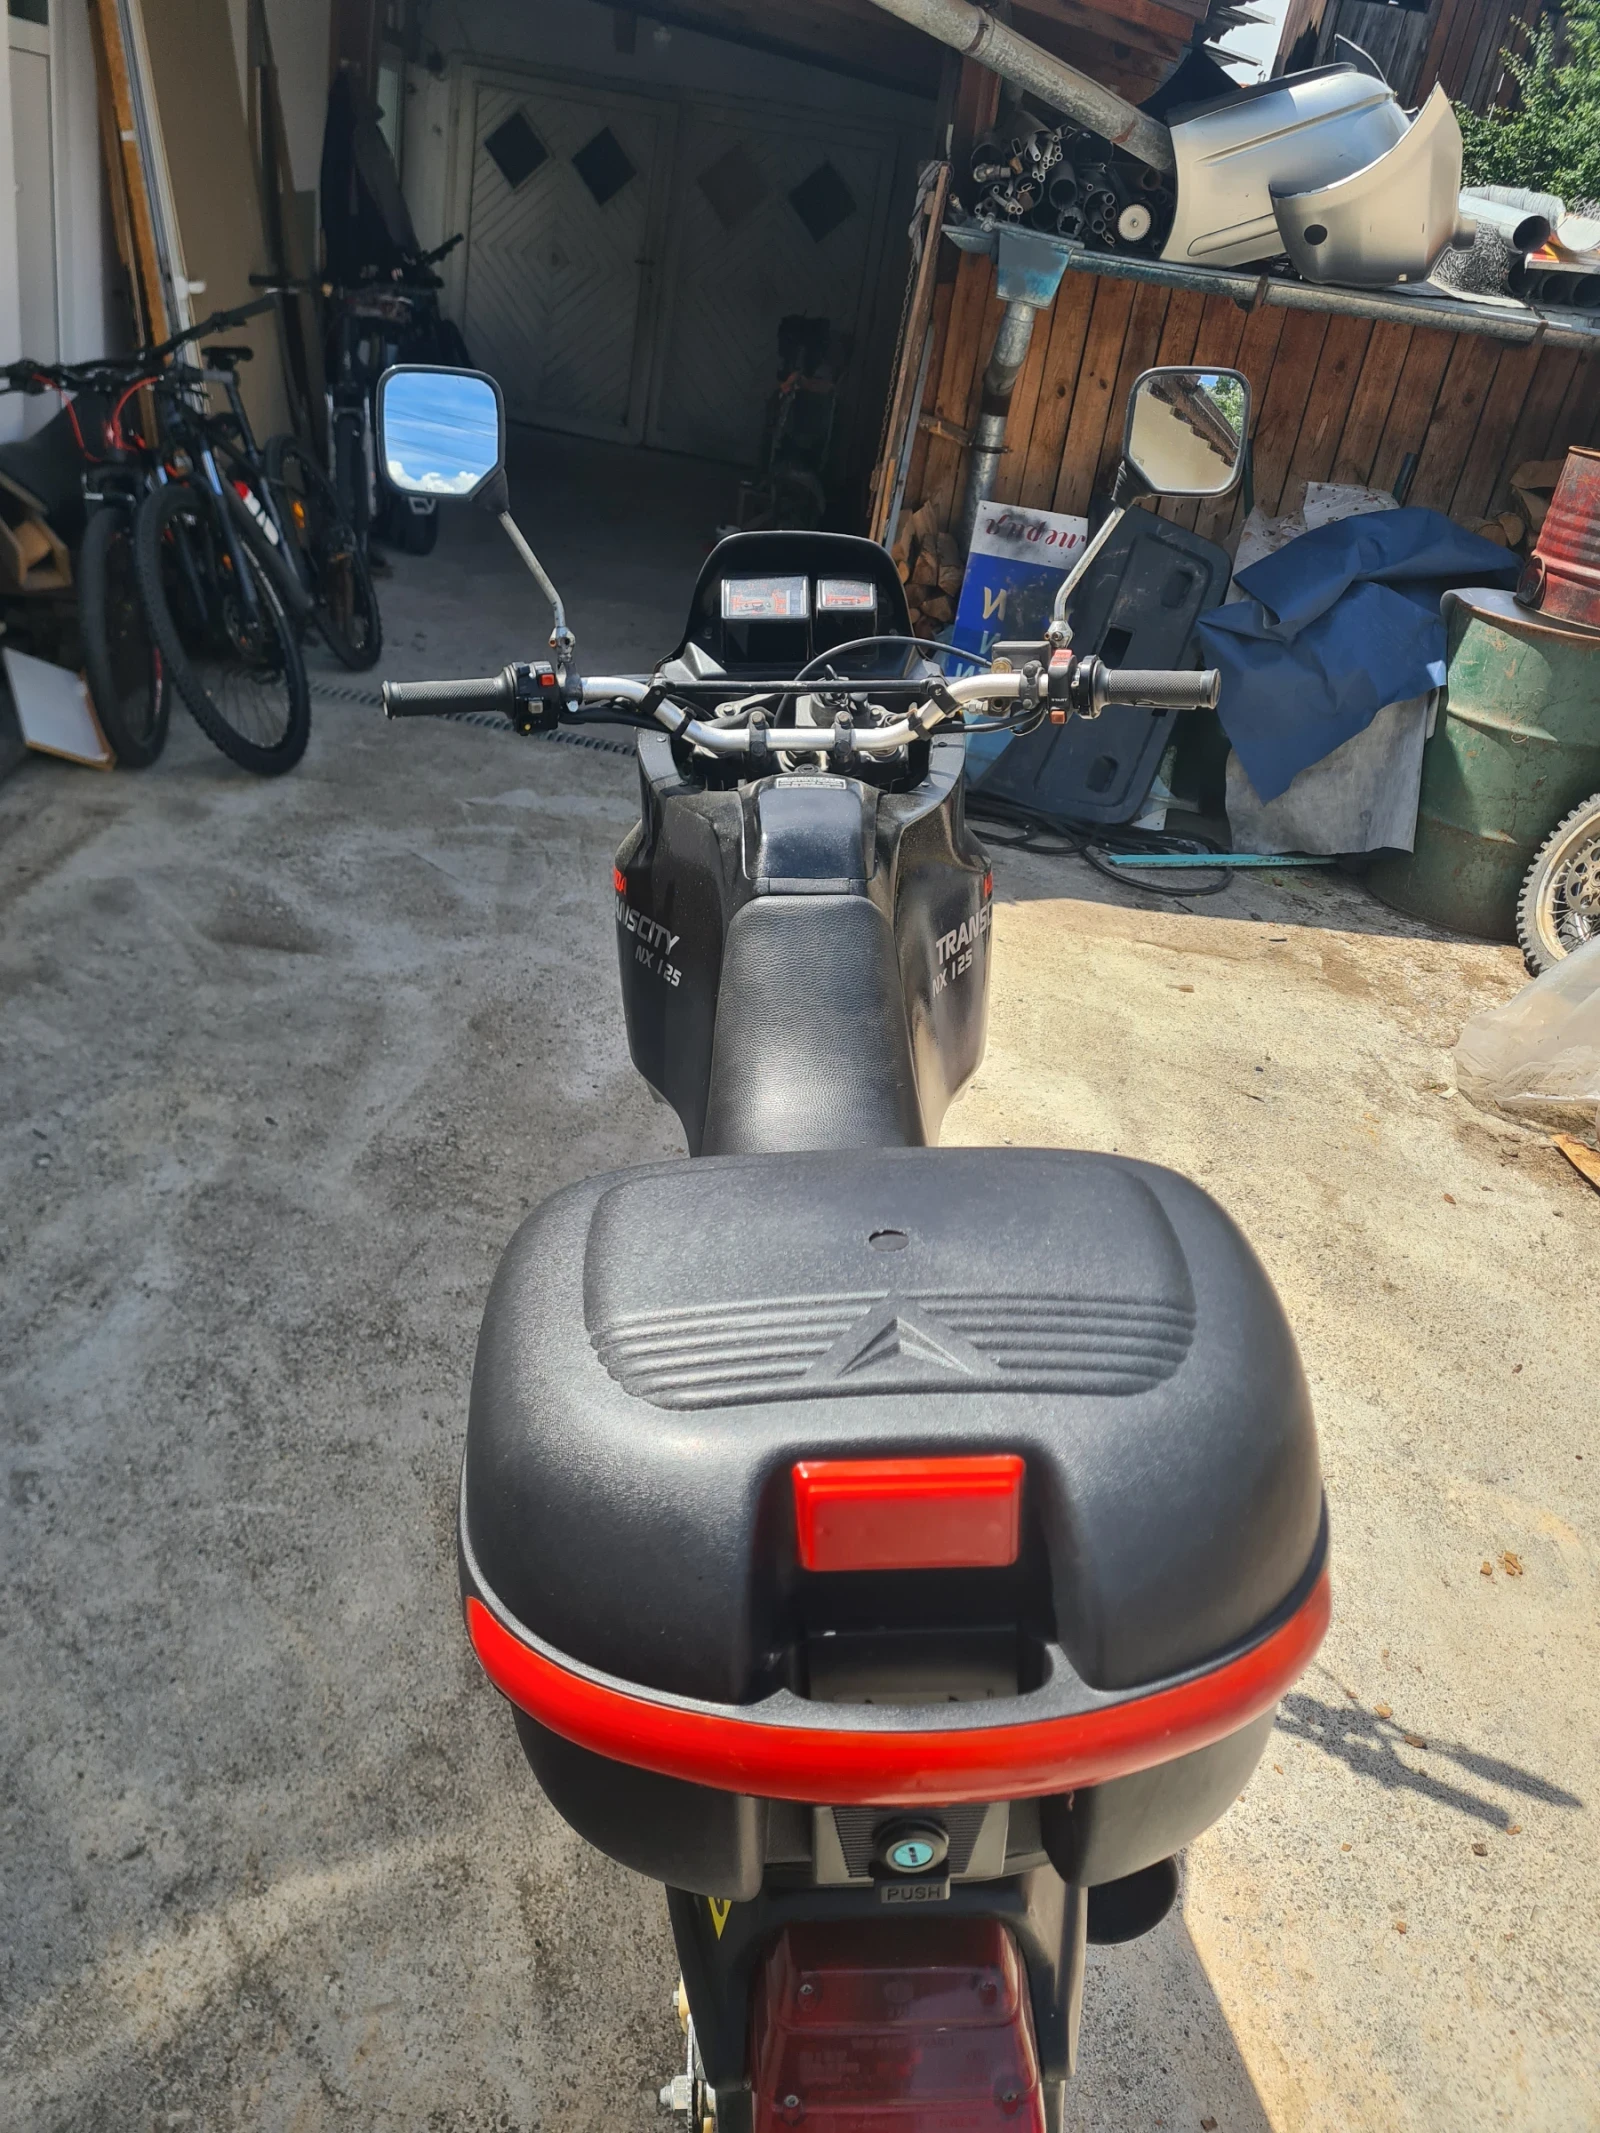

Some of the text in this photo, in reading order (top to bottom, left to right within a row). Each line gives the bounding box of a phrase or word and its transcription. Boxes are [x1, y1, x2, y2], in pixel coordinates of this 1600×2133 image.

[635, 945, 682, 987] NX 125
[932, 947, 972, 997] NX 125
[887, 1886, 941, 1901] PUSH
